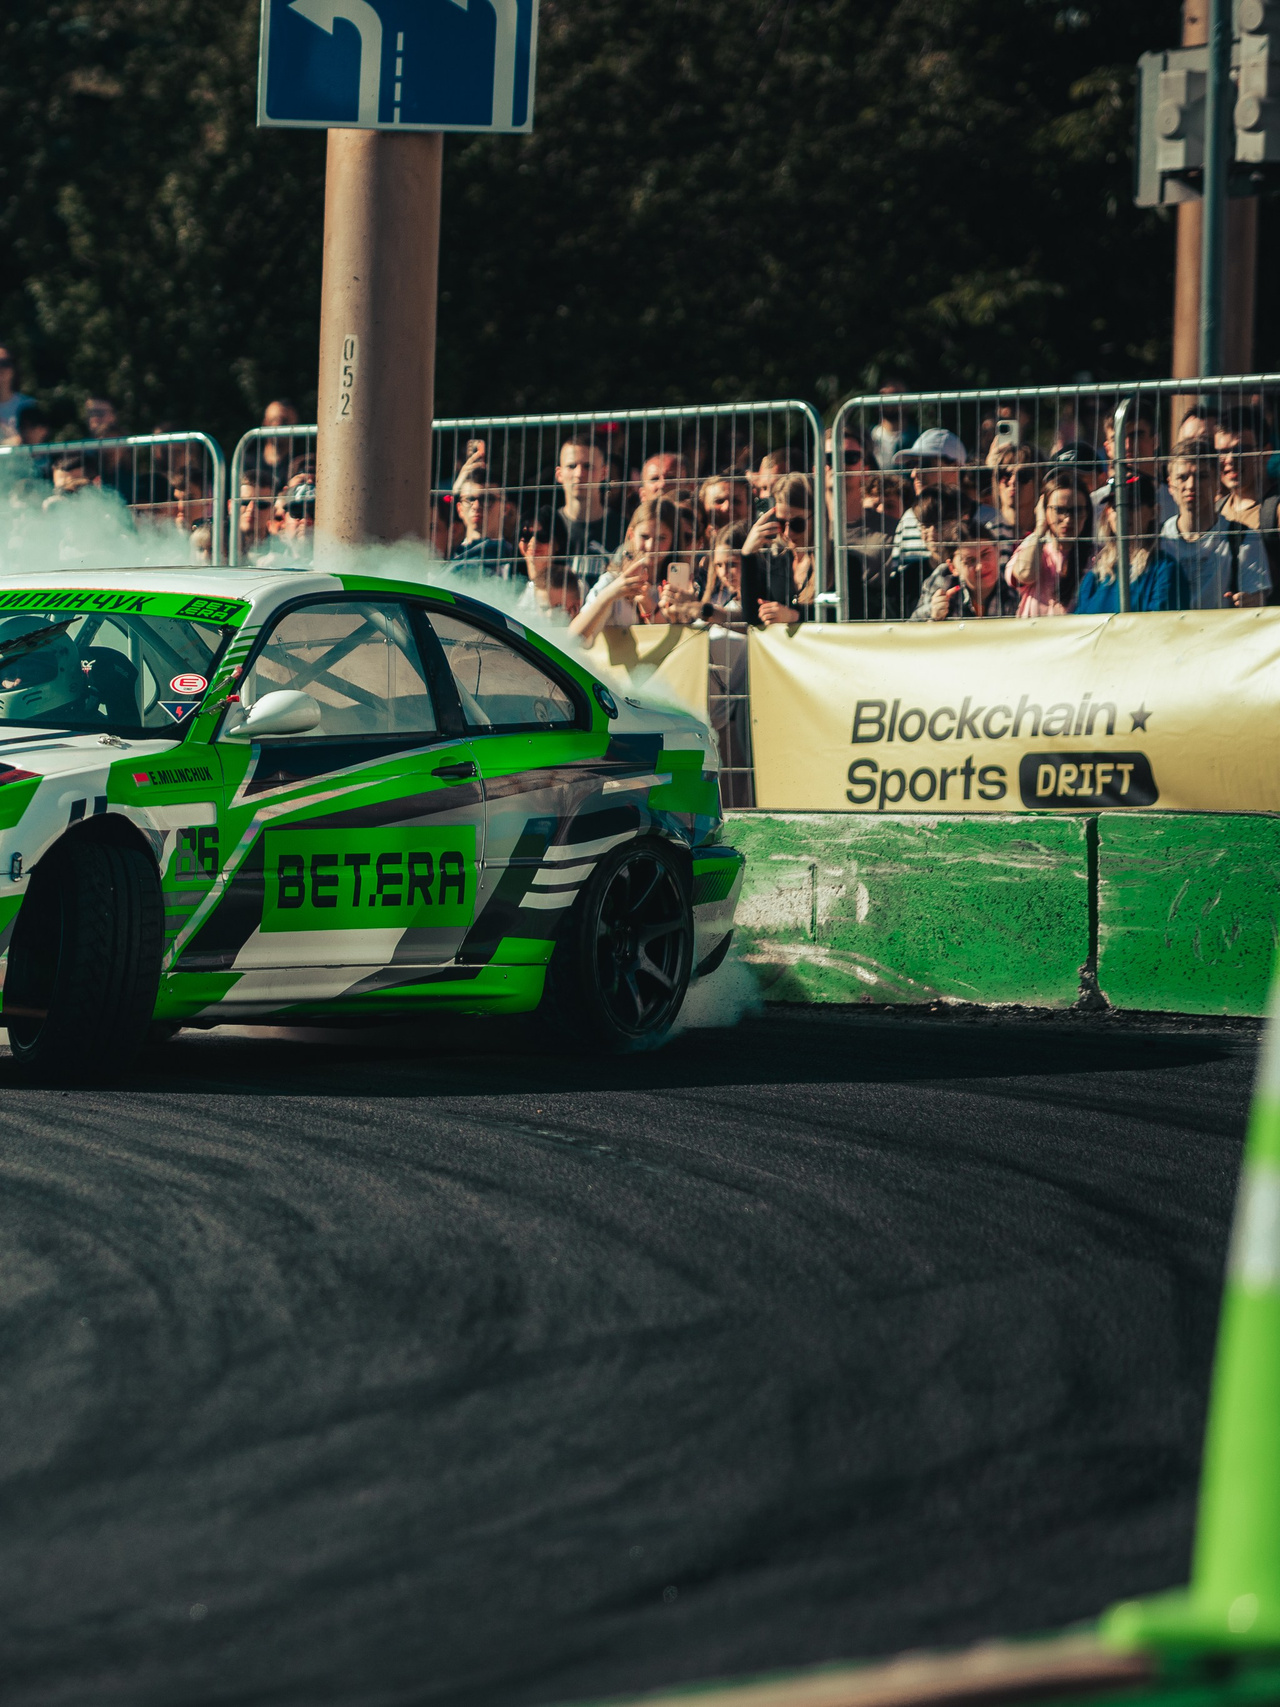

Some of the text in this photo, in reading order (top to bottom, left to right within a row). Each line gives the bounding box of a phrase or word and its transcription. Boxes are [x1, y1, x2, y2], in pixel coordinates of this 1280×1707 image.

[341, 338, 354, 416] 052
[190, 599, 237, 612] BET
[851, 692, 1118, 744] Blockchain
[148, 766, 213, 785] E.MILINCHUK
[846, 754, 1135, 809] Sports DRIFT
[174, 826, 220, 882] 86
